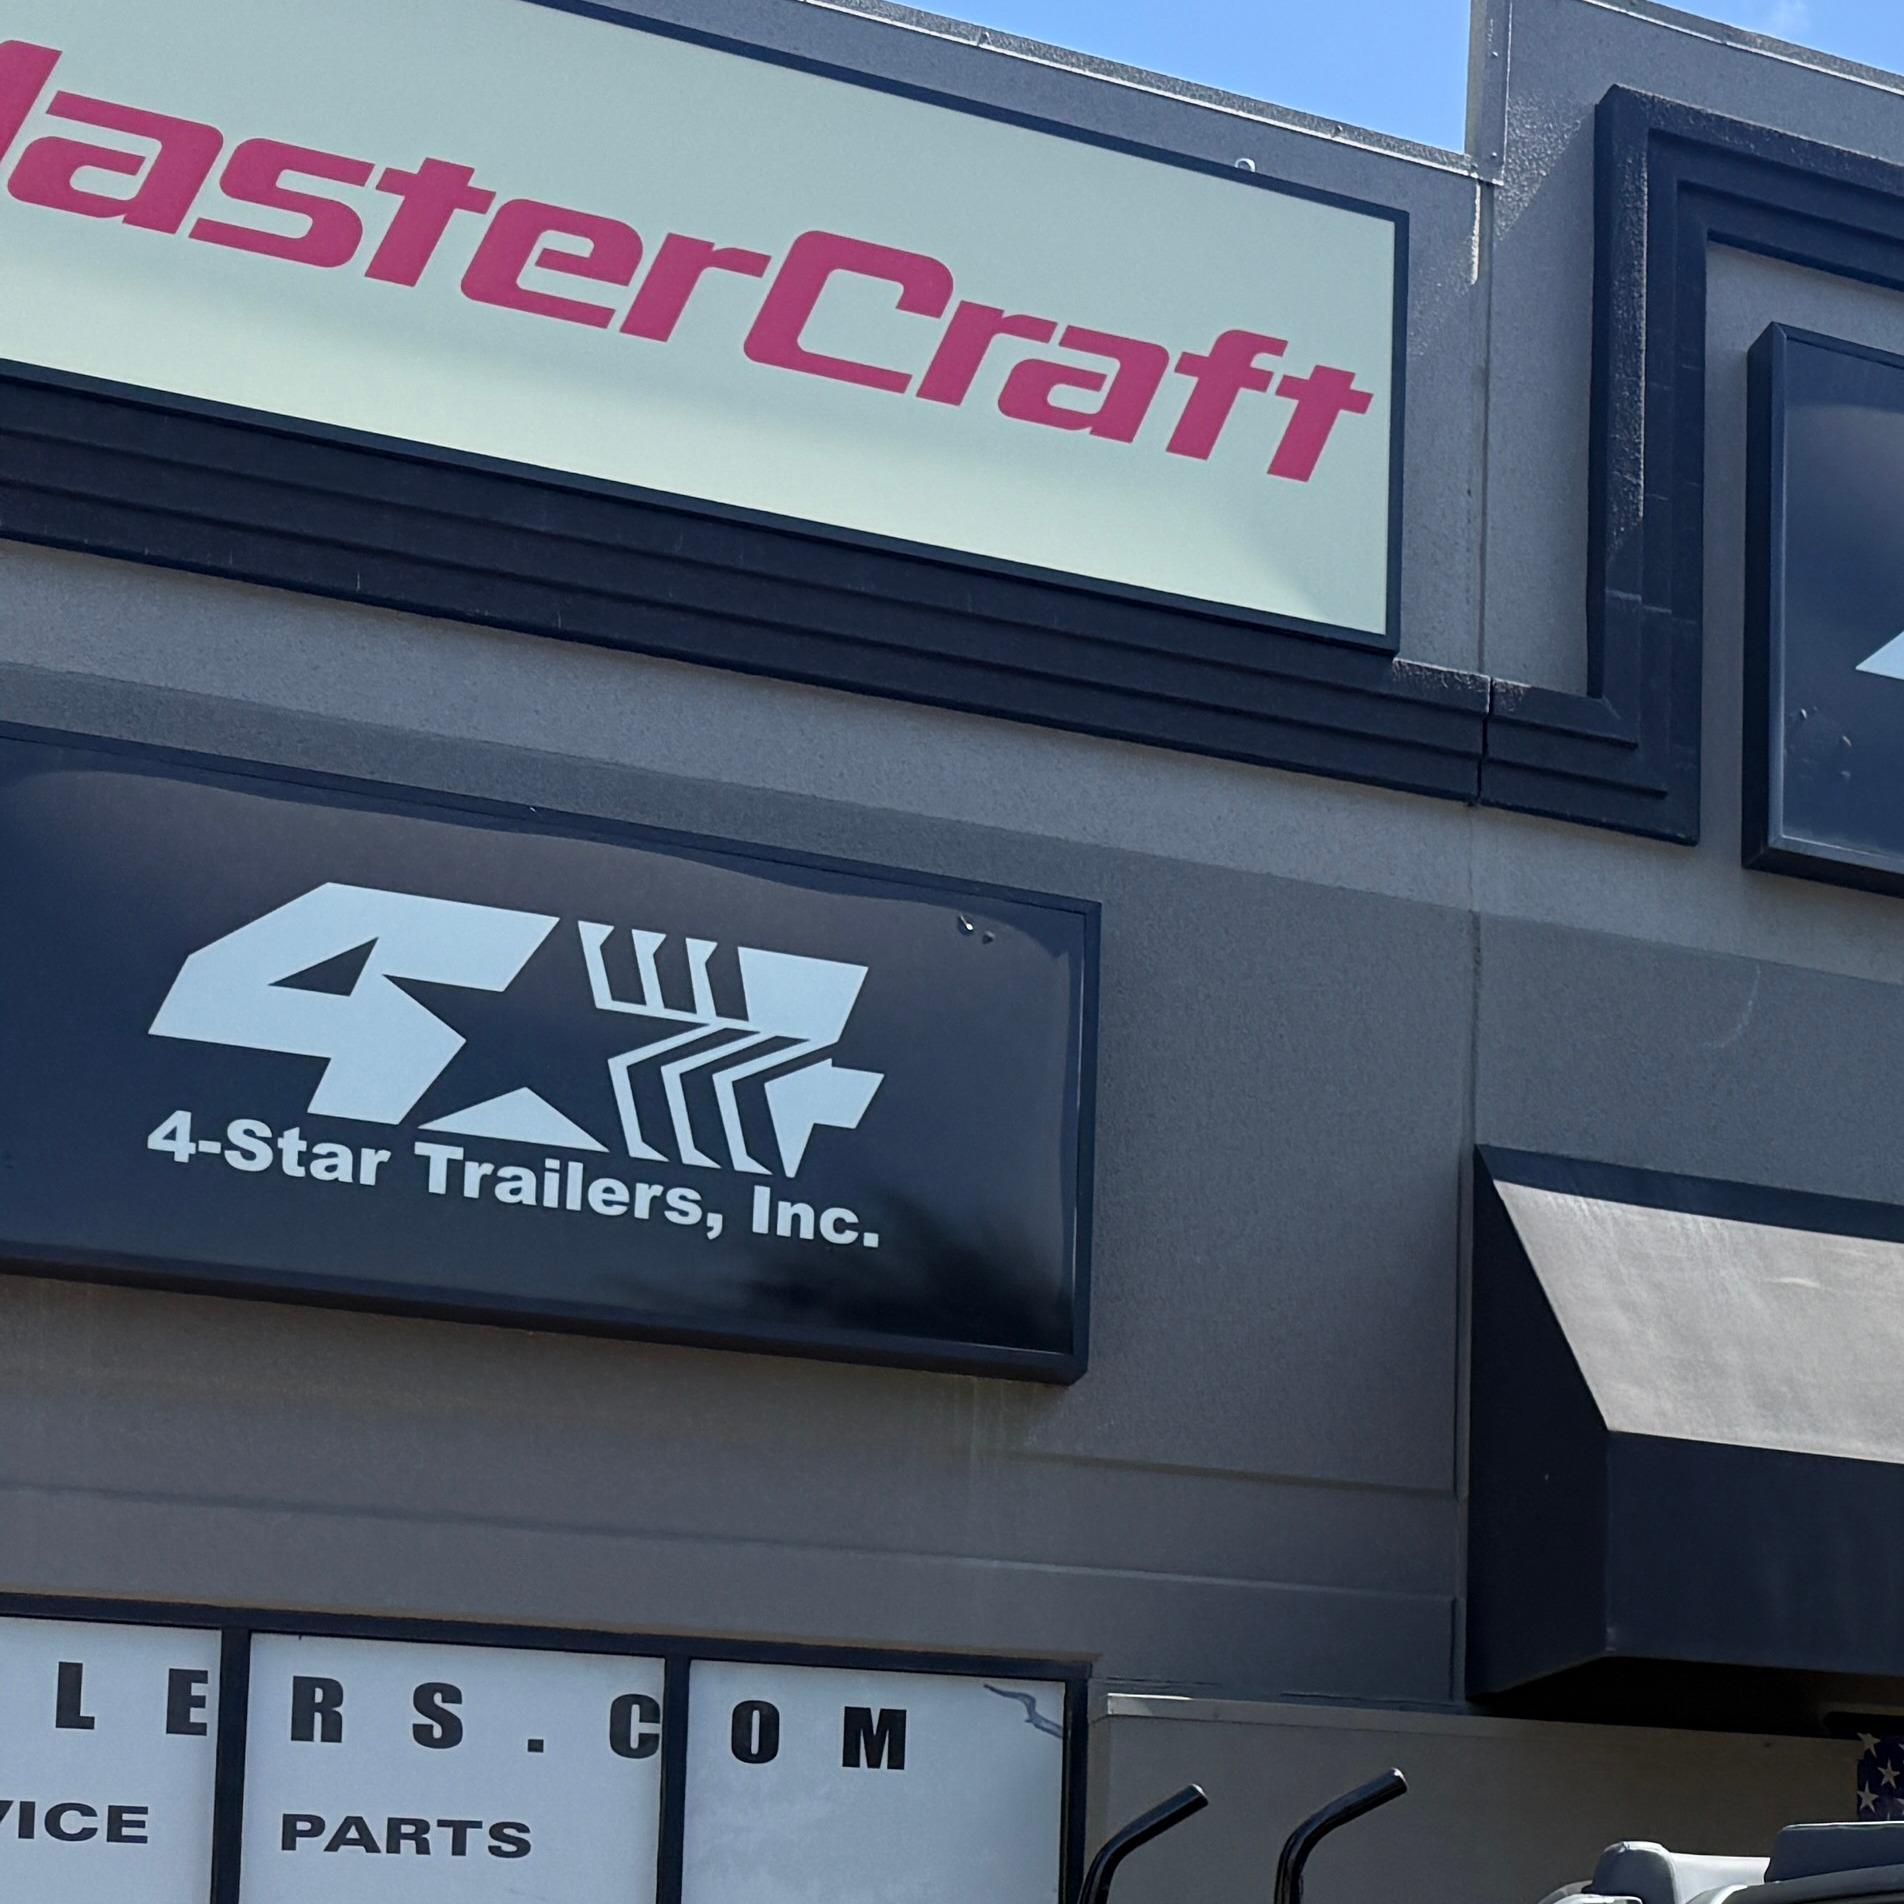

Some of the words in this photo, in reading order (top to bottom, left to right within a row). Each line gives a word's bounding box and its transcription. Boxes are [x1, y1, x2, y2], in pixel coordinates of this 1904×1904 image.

[147, 1109, 393, 1187] 4-Star
[414, 1141, 724, 1241] Trailers,
[752, 1185, 880, 1248] Inc.
[0, 1799, 149, 1844] ICE
[281, 1813, 532, 1859] PARTS
